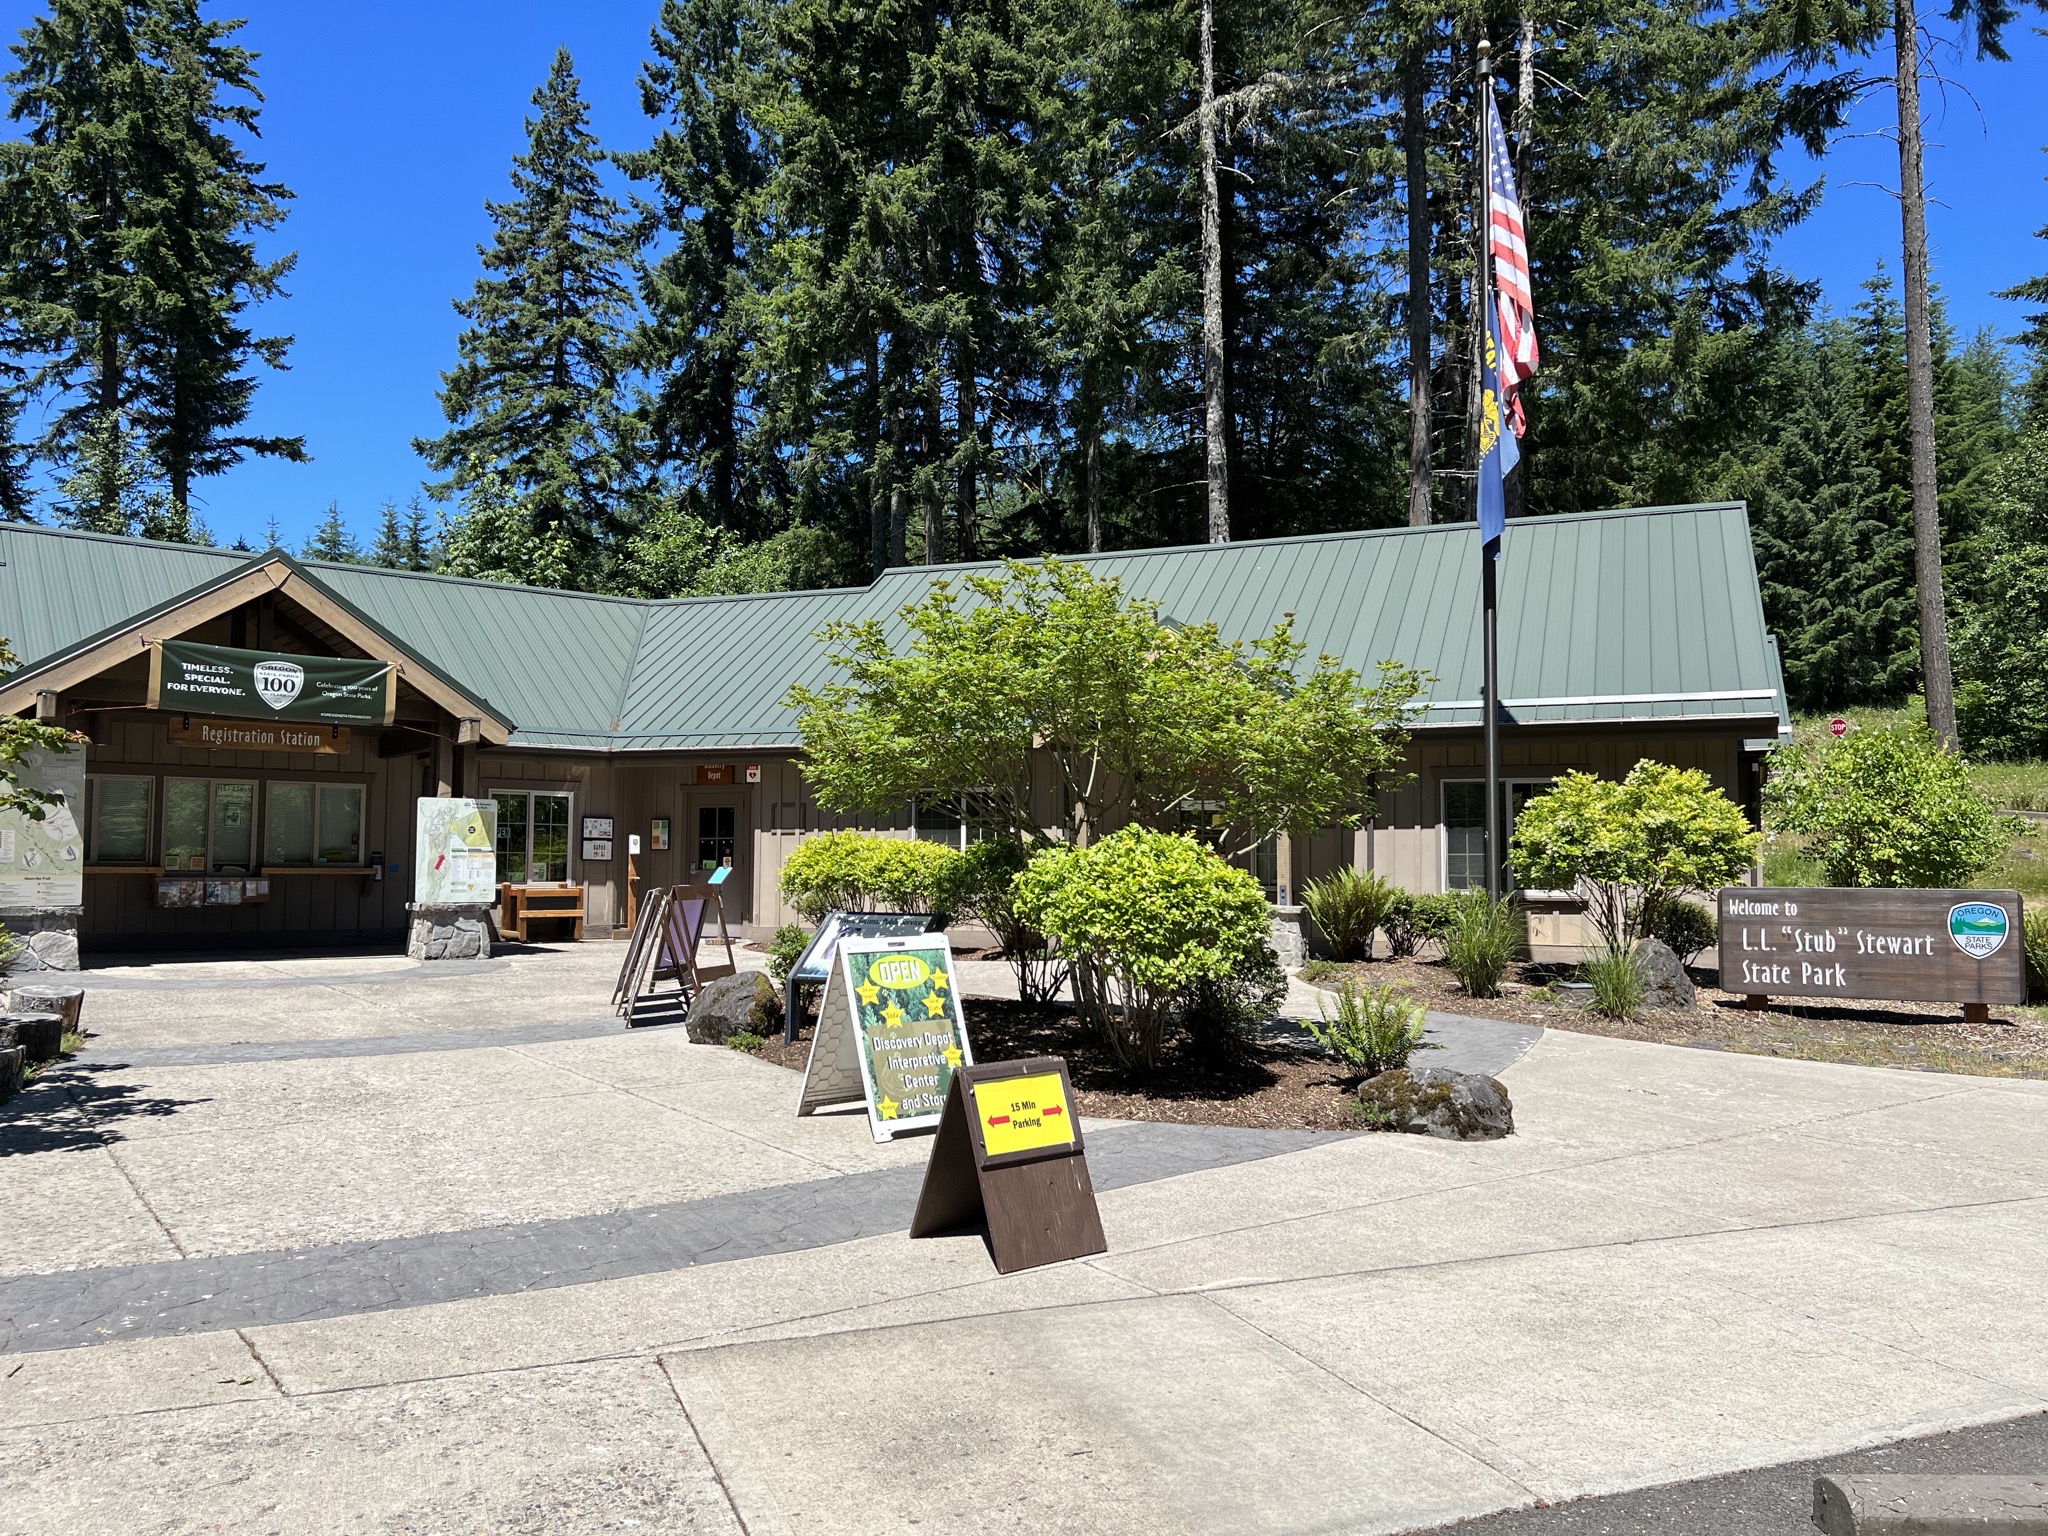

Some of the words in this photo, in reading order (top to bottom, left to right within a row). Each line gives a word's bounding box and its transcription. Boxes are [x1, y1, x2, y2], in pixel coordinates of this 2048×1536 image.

[181, 662, 234, 674] TIMELESS.
[260, 665, 298, 674] OREGON
[184, 673, 231, 684] SPECIAL.
[261, 677, 296, 693] 100
[167, 682, 188, 691] FOR
[190, 684, 246, 696] EVERYONE.
[316, 681, 346, 691] Celebrating
[322, 690, 342, 698] Oregon
[1831, 723, 1846, 731] STOP
[202, 725, 274, 745] Registration
[280, 730, 320, 747] Station
[707, 771, 721, 780] Depot
[1729, 899, 1779, 916] Welcome
[1784, 901, 1798, 916] to
[1957, 907, 1999, 918] OREGON
[1742, 927, 1777, 951] L.L.
[1856, 930, 1935, 956] Stewart
[1964, 942, 1993, 950] PARKS
[878, 960, 922, 983] OPEN
[1742, 959, 1791, 984] State
[1801, 961, 1847, 987] Park
[872, 1036, 922, 1051] Discovery
[923, 1031, 953, 1047] Depot
[887, 1052, 947, 1070] Interpretive
[904, 1074, 938, 1089] Center
[902, 1095, 920, 1110] and
[1010, 1102, 1021, 1112] 15
[1022, 1101, 1037, 1110] Min
[1013, 1117, 1042, 1129] Parking
